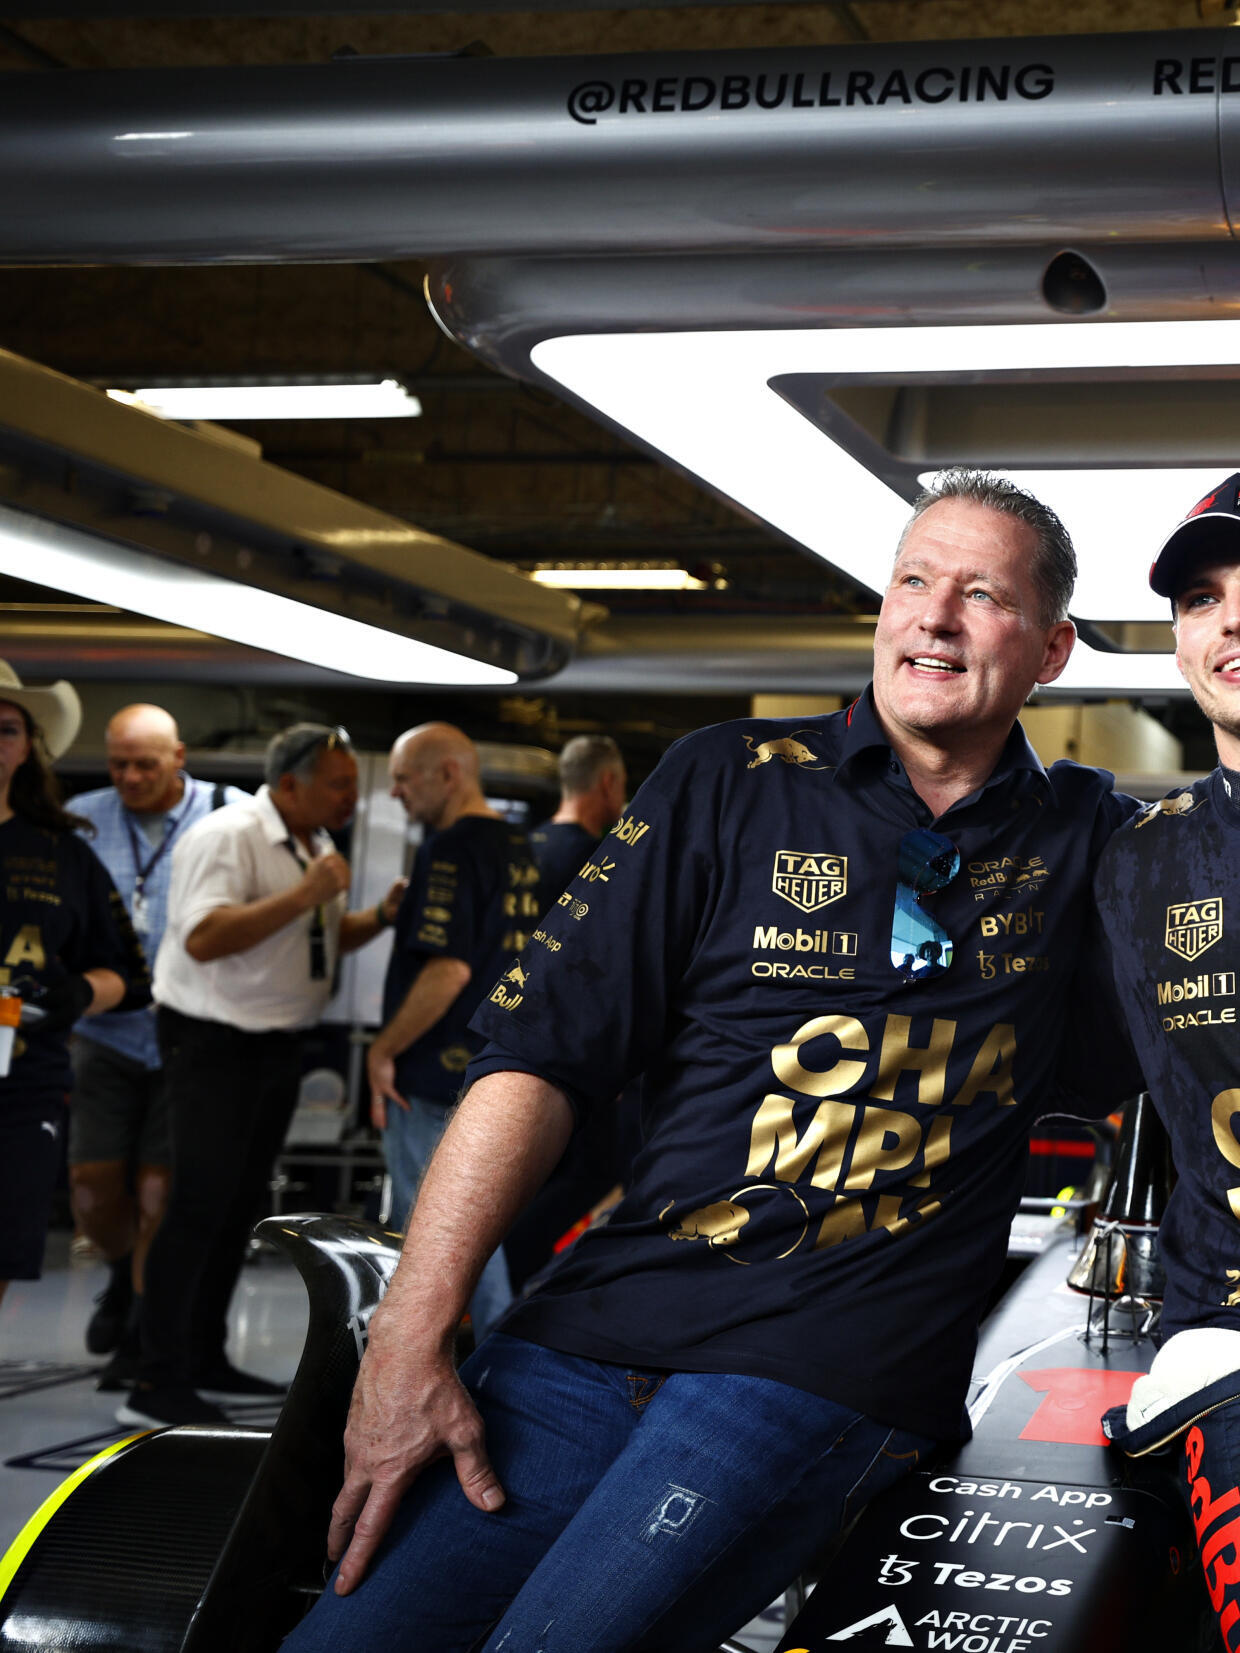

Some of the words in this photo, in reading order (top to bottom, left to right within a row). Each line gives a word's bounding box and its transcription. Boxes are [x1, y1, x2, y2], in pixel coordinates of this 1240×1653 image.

[568, 63, 1056, 125] @REDBULLRACING
[781, 854, 842, 876] TAG
[777, 880, 843, 909] HEUER
[980, 906, 1045, 937] BYBIT
[1170, 902, 1218, 925] TAG
[752, 925, 828, 953] Mobil
[1168, 925, 1219, 958] HEUER
[751, 961, 856, 980] ORACLE
[490, 984, 524, 1012] Bull
[1157, 974, 1210, 1006] Mobil
[1162, 1007, 1237, 1032] ORACLE
[771, 1013, 1018, 1106] CHA
[744, 1093, 954, 1191] MPI
[928, 1477, 1023, 1499] Cash
[1029, 1485, 1113, 1509] App
[932, 1561, 1075, 1597] Tezos
[914, 1609, 1053, 1638] ARCTIC
[926, 1630, 1033, 1653] WOLF
